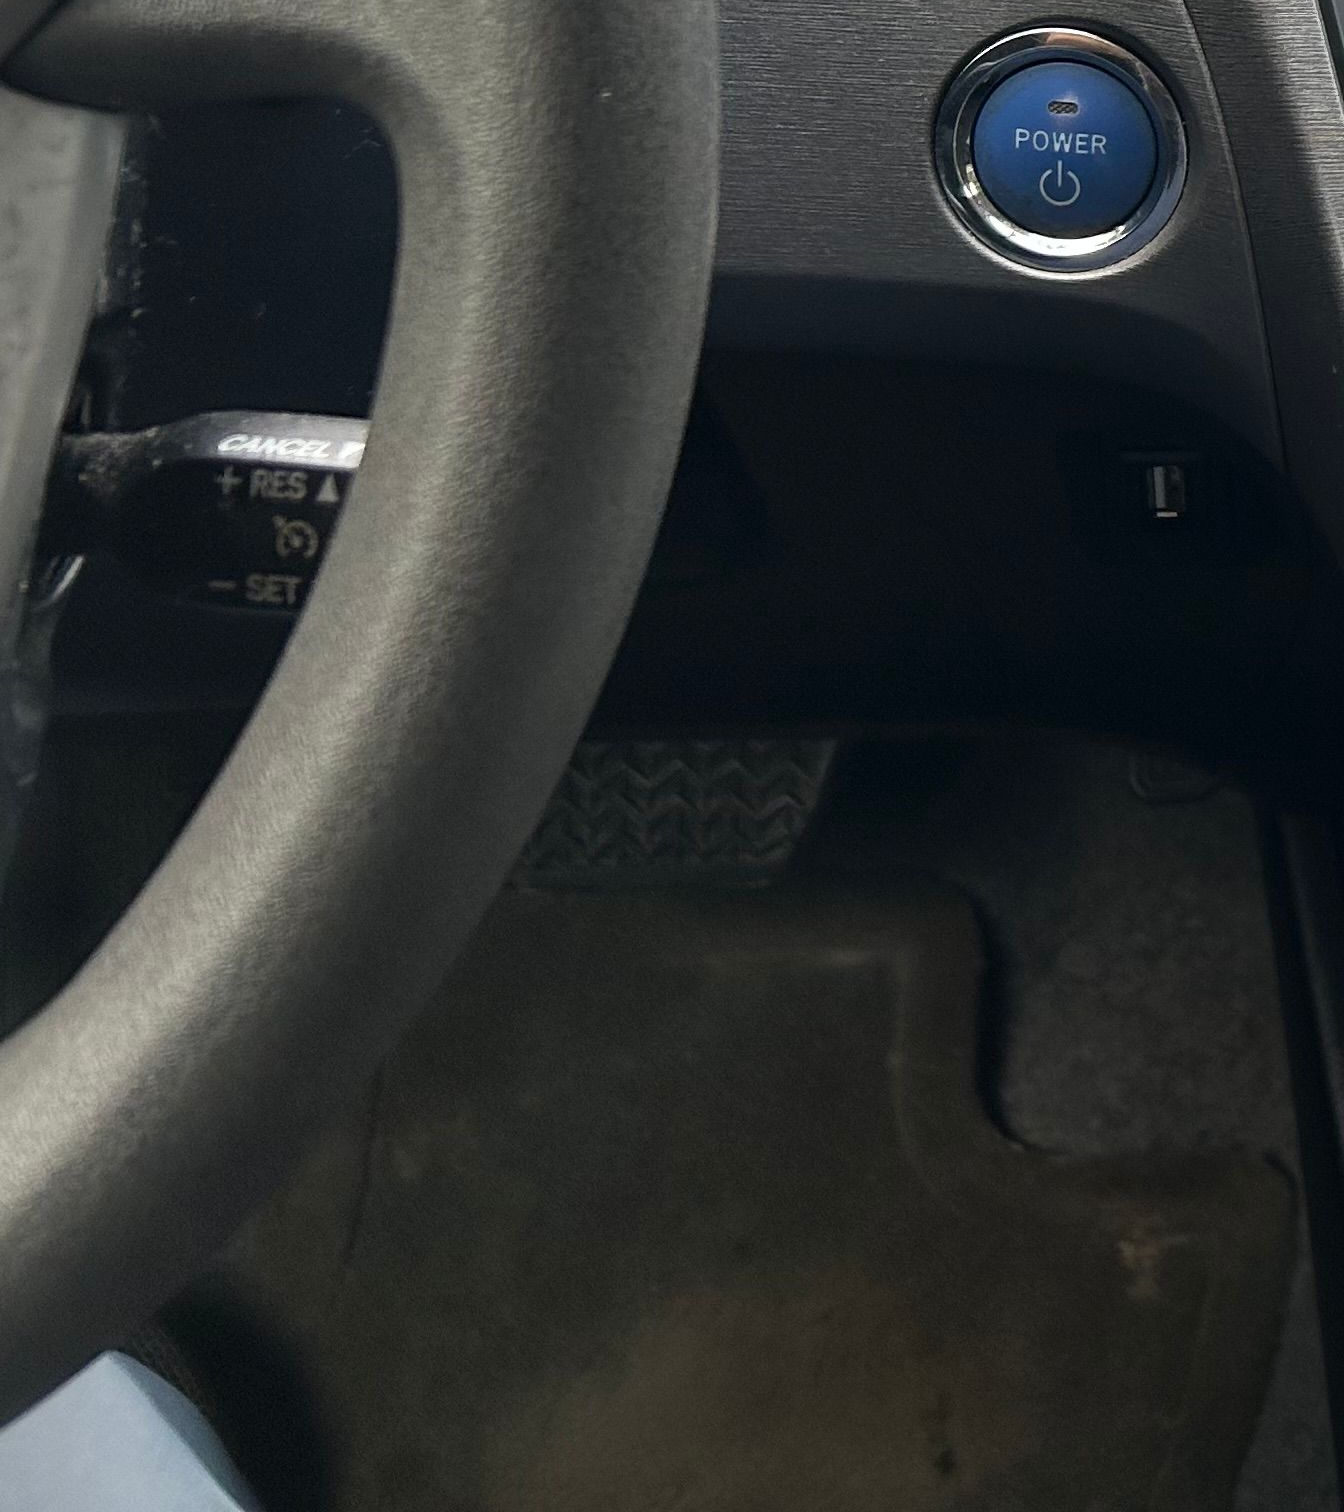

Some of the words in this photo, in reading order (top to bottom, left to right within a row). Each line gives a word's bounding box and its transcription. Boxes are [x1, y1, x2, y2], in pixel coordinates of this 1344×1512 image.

[1015, 128, 1107, 155] POWER
[217, 434, 330, 459] CANCEL
[250, 469, 307, 500] RES
[247, 575, 300, 604] SET
